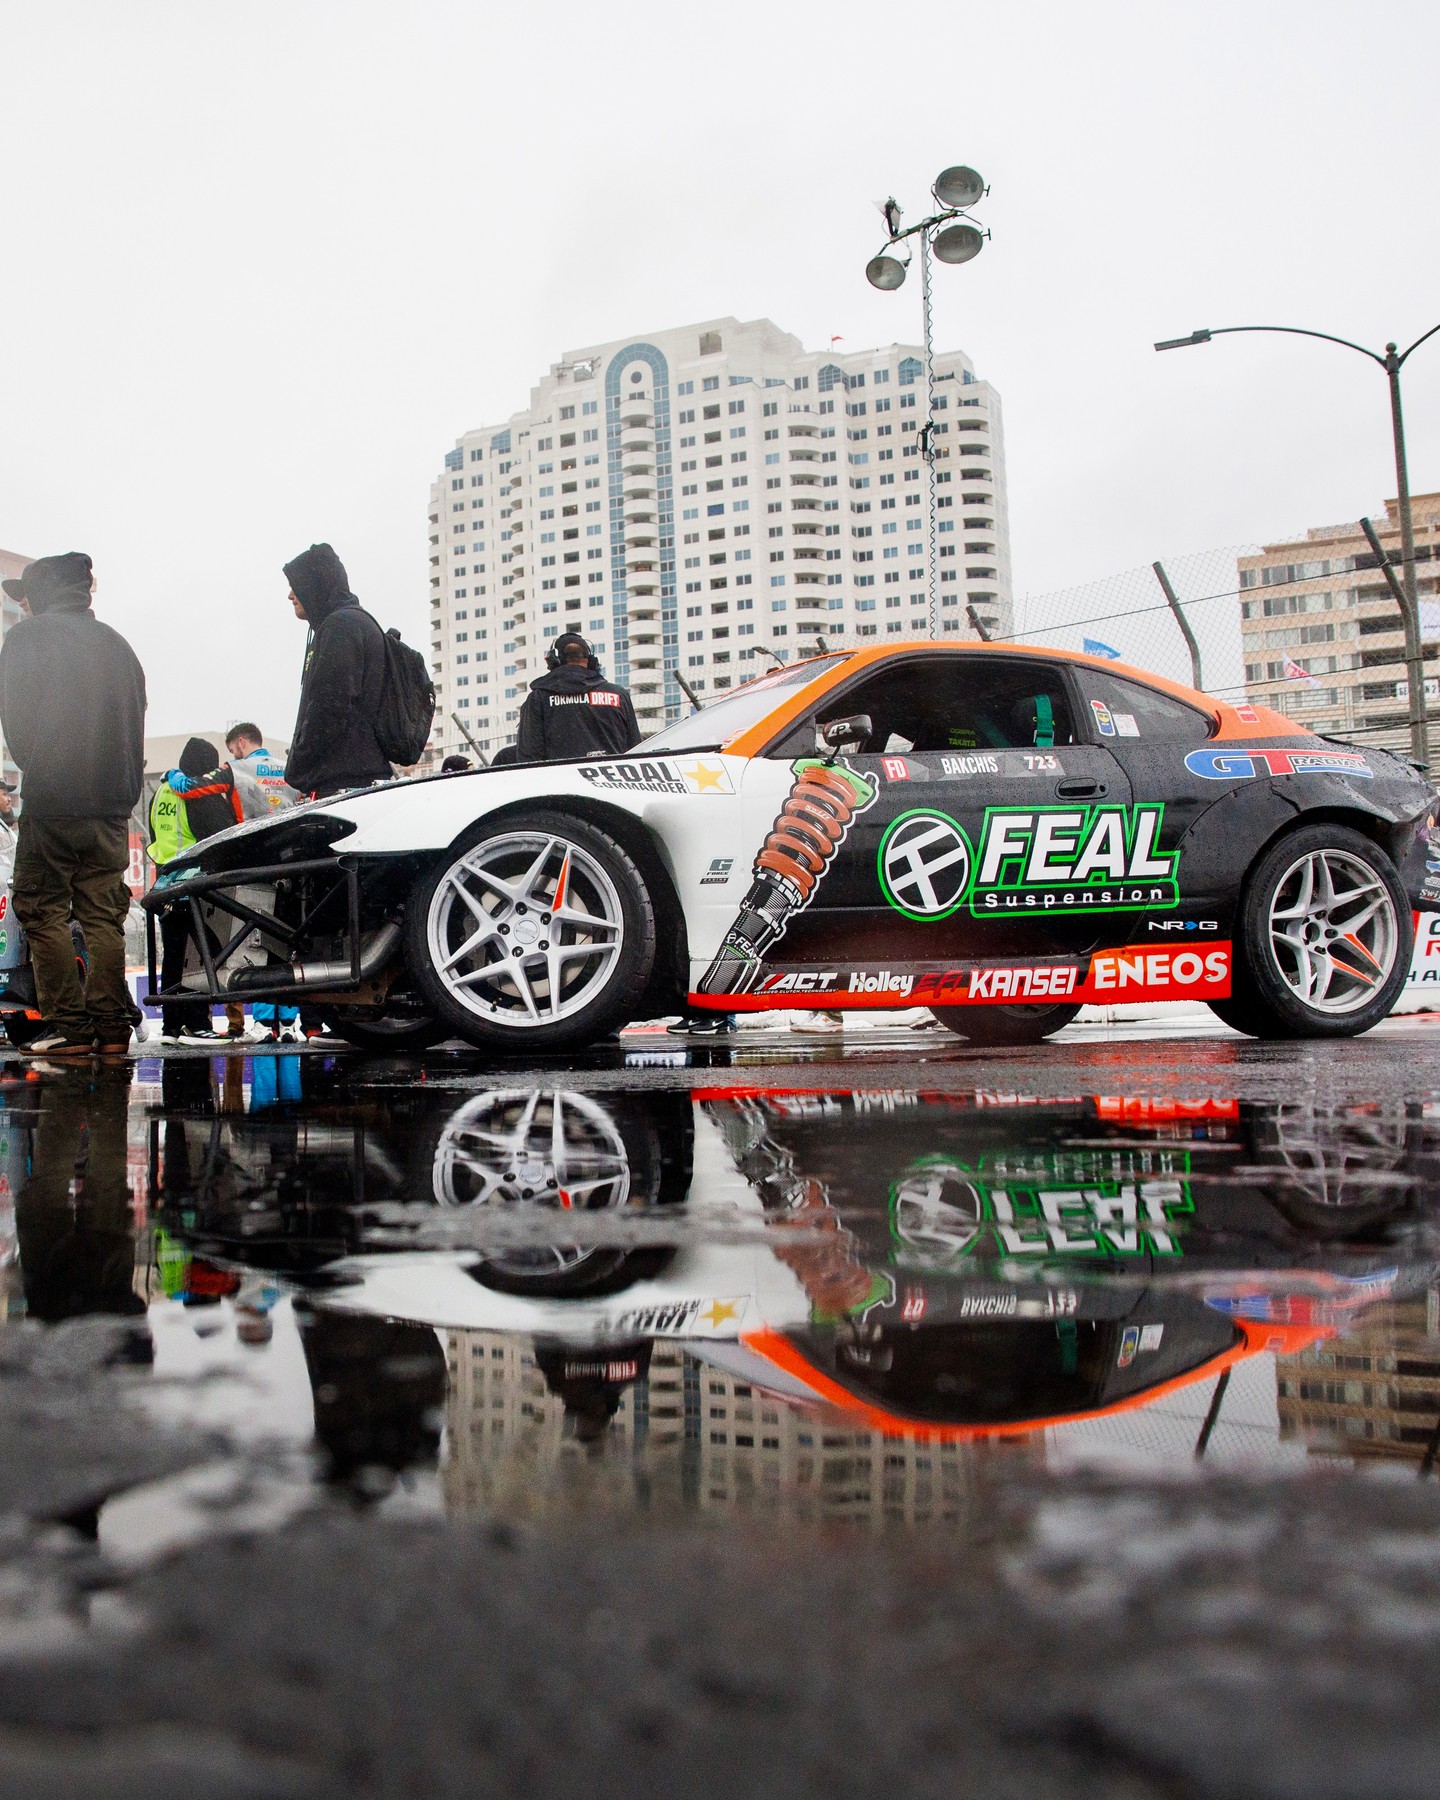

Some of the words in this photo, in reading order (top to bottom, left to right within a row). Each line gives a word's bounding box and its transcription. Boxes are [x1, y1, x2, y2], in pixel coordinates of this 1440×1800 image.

[549, 693, 590, 707] FORMULA
[591, 691, 620, 707] DRIFT
[948, 738, 976, 747] TAKATA
[884, 759, 907, 779] FD
[940, 756, 999, 775] BAKCHIS
[1023, 755, 1057, 770] 723
[1185, 749, 1365, 779] GT
[1291, 757, 1370, 770] RADIAL
[578, 762, 681, 783] PEDAL
[593, 782, 688, 794] COMMANDER
[158, 802, 177, 816] 204
[979, 810, 1171, 883] FEAL
[985, 886, 1163, 908] Suspension
[1093, 951, 1228, 989] ENEOS
[768, 973, 838, 990] ACT
[848, 971, 914, 998] Holley
[968, 967, 1078, 998] KANSEI
